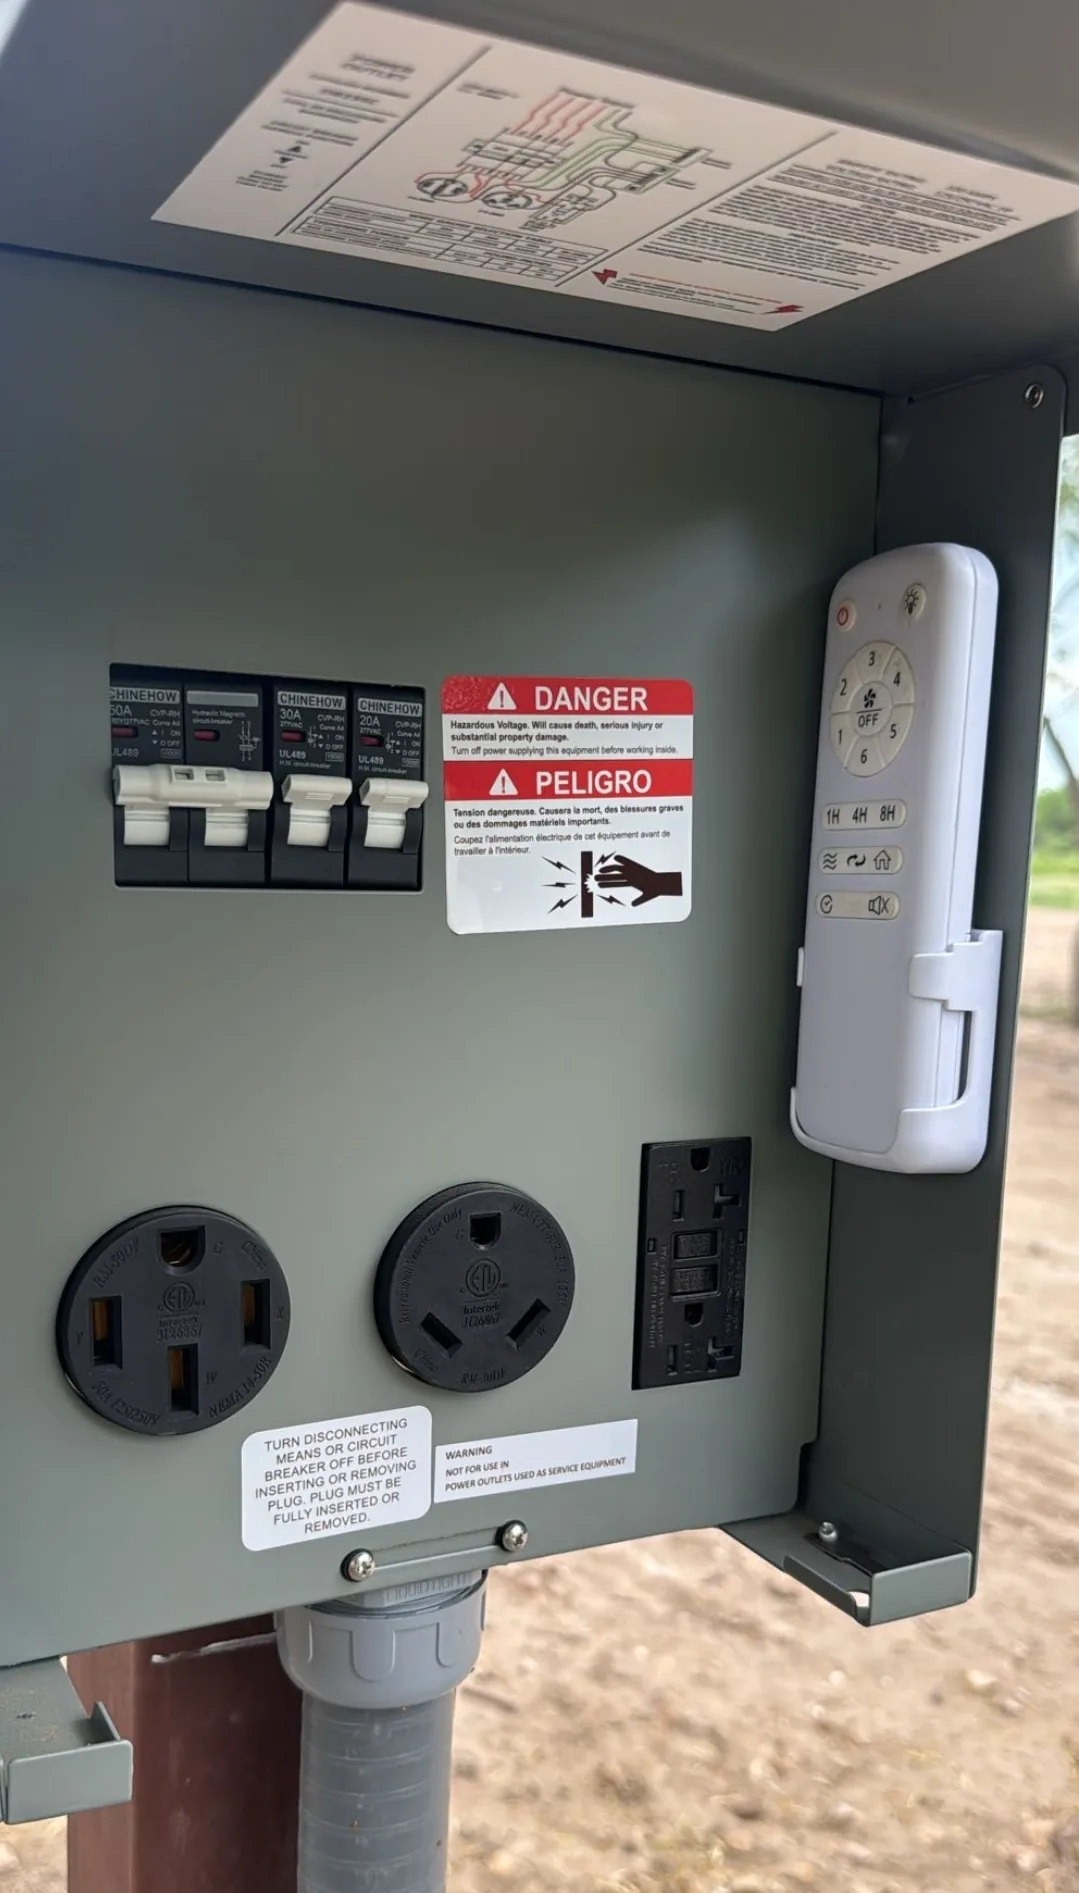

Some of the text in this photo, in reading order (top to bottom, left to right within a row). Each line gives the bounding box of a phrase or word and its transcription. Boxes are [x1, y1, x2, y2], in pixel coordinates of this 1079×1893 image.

[868, 651, 876, 667] 3
[893, 672, 901, 687] 4
[839, 679, 848, 696] 2
[280, 693, 343, 708] CHINEHOW
[535, 686, 648, 711] DANGER
[279, 708, 302, 720] 30A
[360, 699, 420, 715] CHINEHOW
[359, 715, 381, 727] 20A
[451, 720, 663, 733] Hazardous Voltage. Will cause death, serious injury or
[858, 714, 879, 728] OFF
[451, 732, 569, 744] substantial property damage.
[837, 728, 843, 744] 1
[889, 724, 897, 739] 5
[279, 749, 306, 760] UL489
[451, 745, 677, 758] Turn off power supplying this equipment before working inside.
[860, 749, 868, 764] 6
[358, 754, 384, 765] UL489
[536, 769, 652, 795] PELIGRO
[454, 804, 683, 819] Tension dangereuse. Causera la mort, des blessures graves
[826, 806, 895, 824] 1H 4H 8H
[454, 816, 612, 830] ou des dommages matériels importants.
[454, 830, 671, 847] Coupez l'alimentation électrique de cet équipement avant de
[454, 845, 531, 857] travailler à l'intérieur.
[463, 1301, 500, 1315] Intertek
[264, 1418, 408, 1452] TURN DISCONNECTING
[276, 1434, 397, 1465] MEANS OR CIRCUIT
[445, 1445, 493, 1460] WARNING
[264, 1446, 408, 1482] BREAKER OFF BEFORE
[446, 1460, 510, 1478] NOT FOR USE IN
[255, 1459, 416, 1499] INSERTING OR REMOVING
[445, 1456, 627, 1492] POWER OUTLETS USED AS SERVICE EQUIPMENT
[268, 1477, 401, 1511] PLUG. PLUG MUST BE
[273, 1491, 400, 1525] FULLY INSERTED OR
[304, 1512, 370, 1534] REMOVED.
